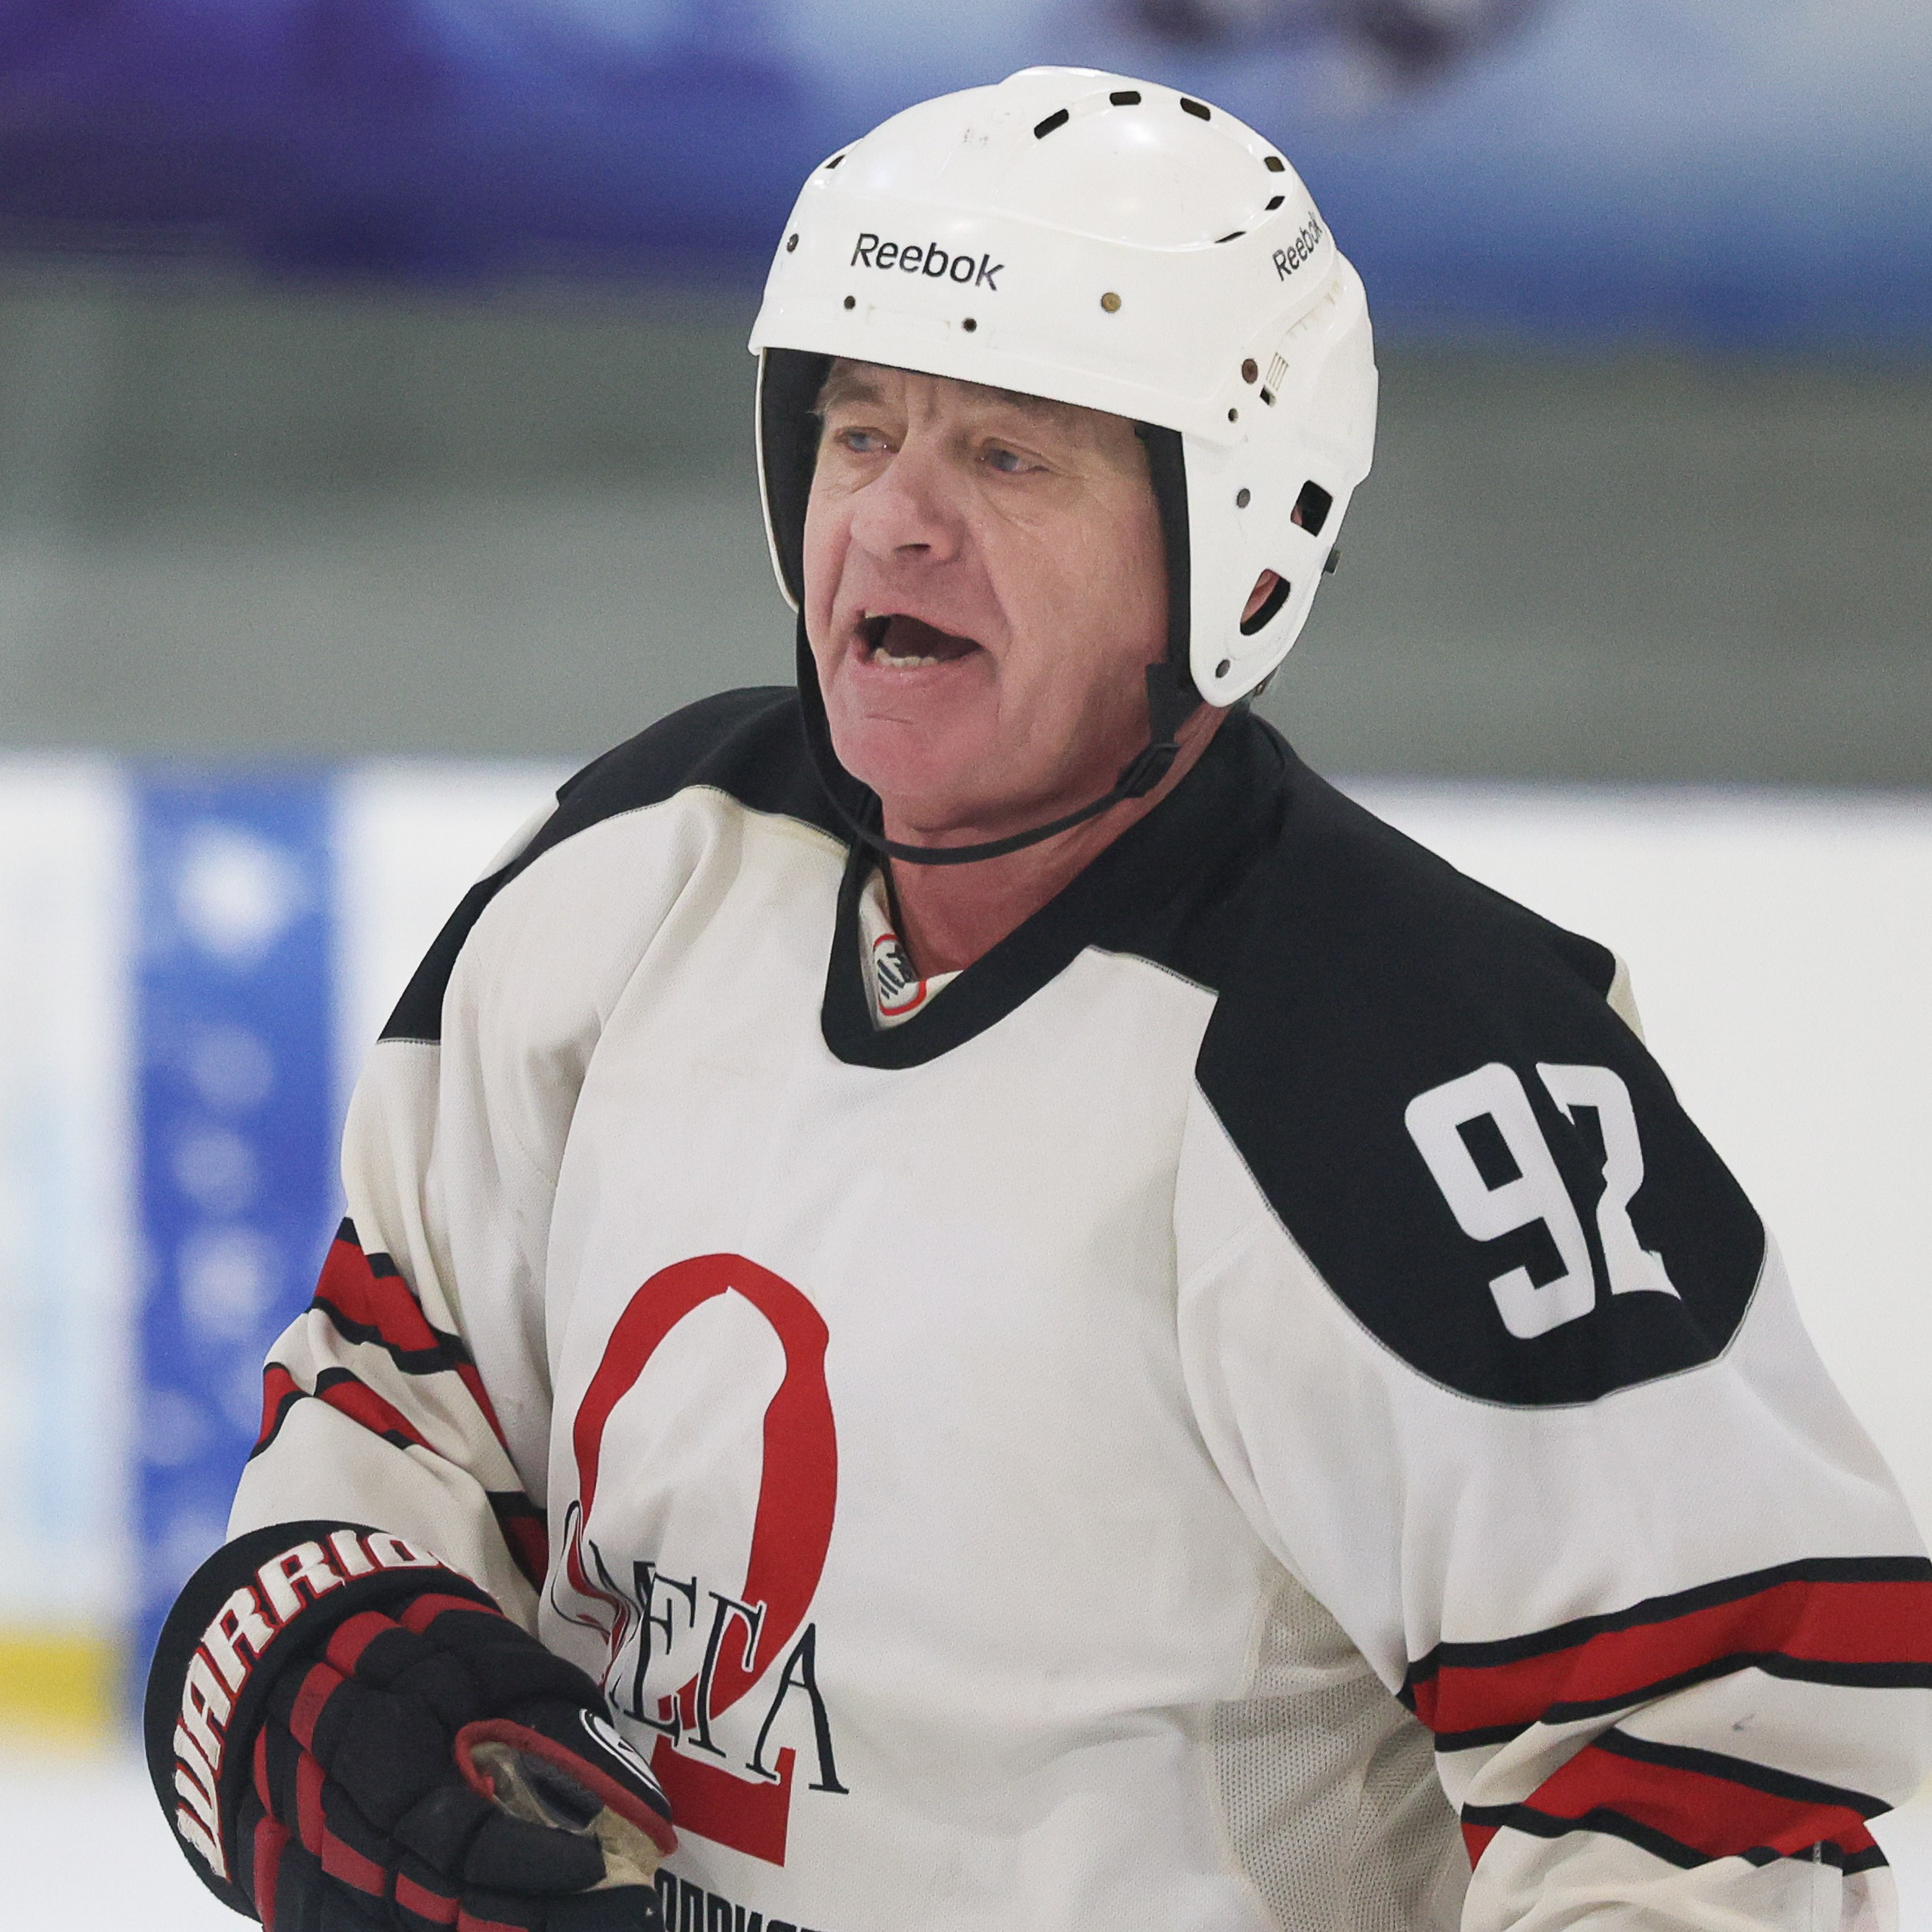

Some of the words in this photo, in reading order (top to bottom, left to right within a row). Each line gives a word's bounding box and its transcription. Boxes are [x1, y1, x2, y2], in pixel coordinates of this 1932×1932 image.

[851, 232, 1005, 291] Reebok
[1272, 211, 1323, 282] Reebok
[173, 1527, 453, 1882] WARRIO
